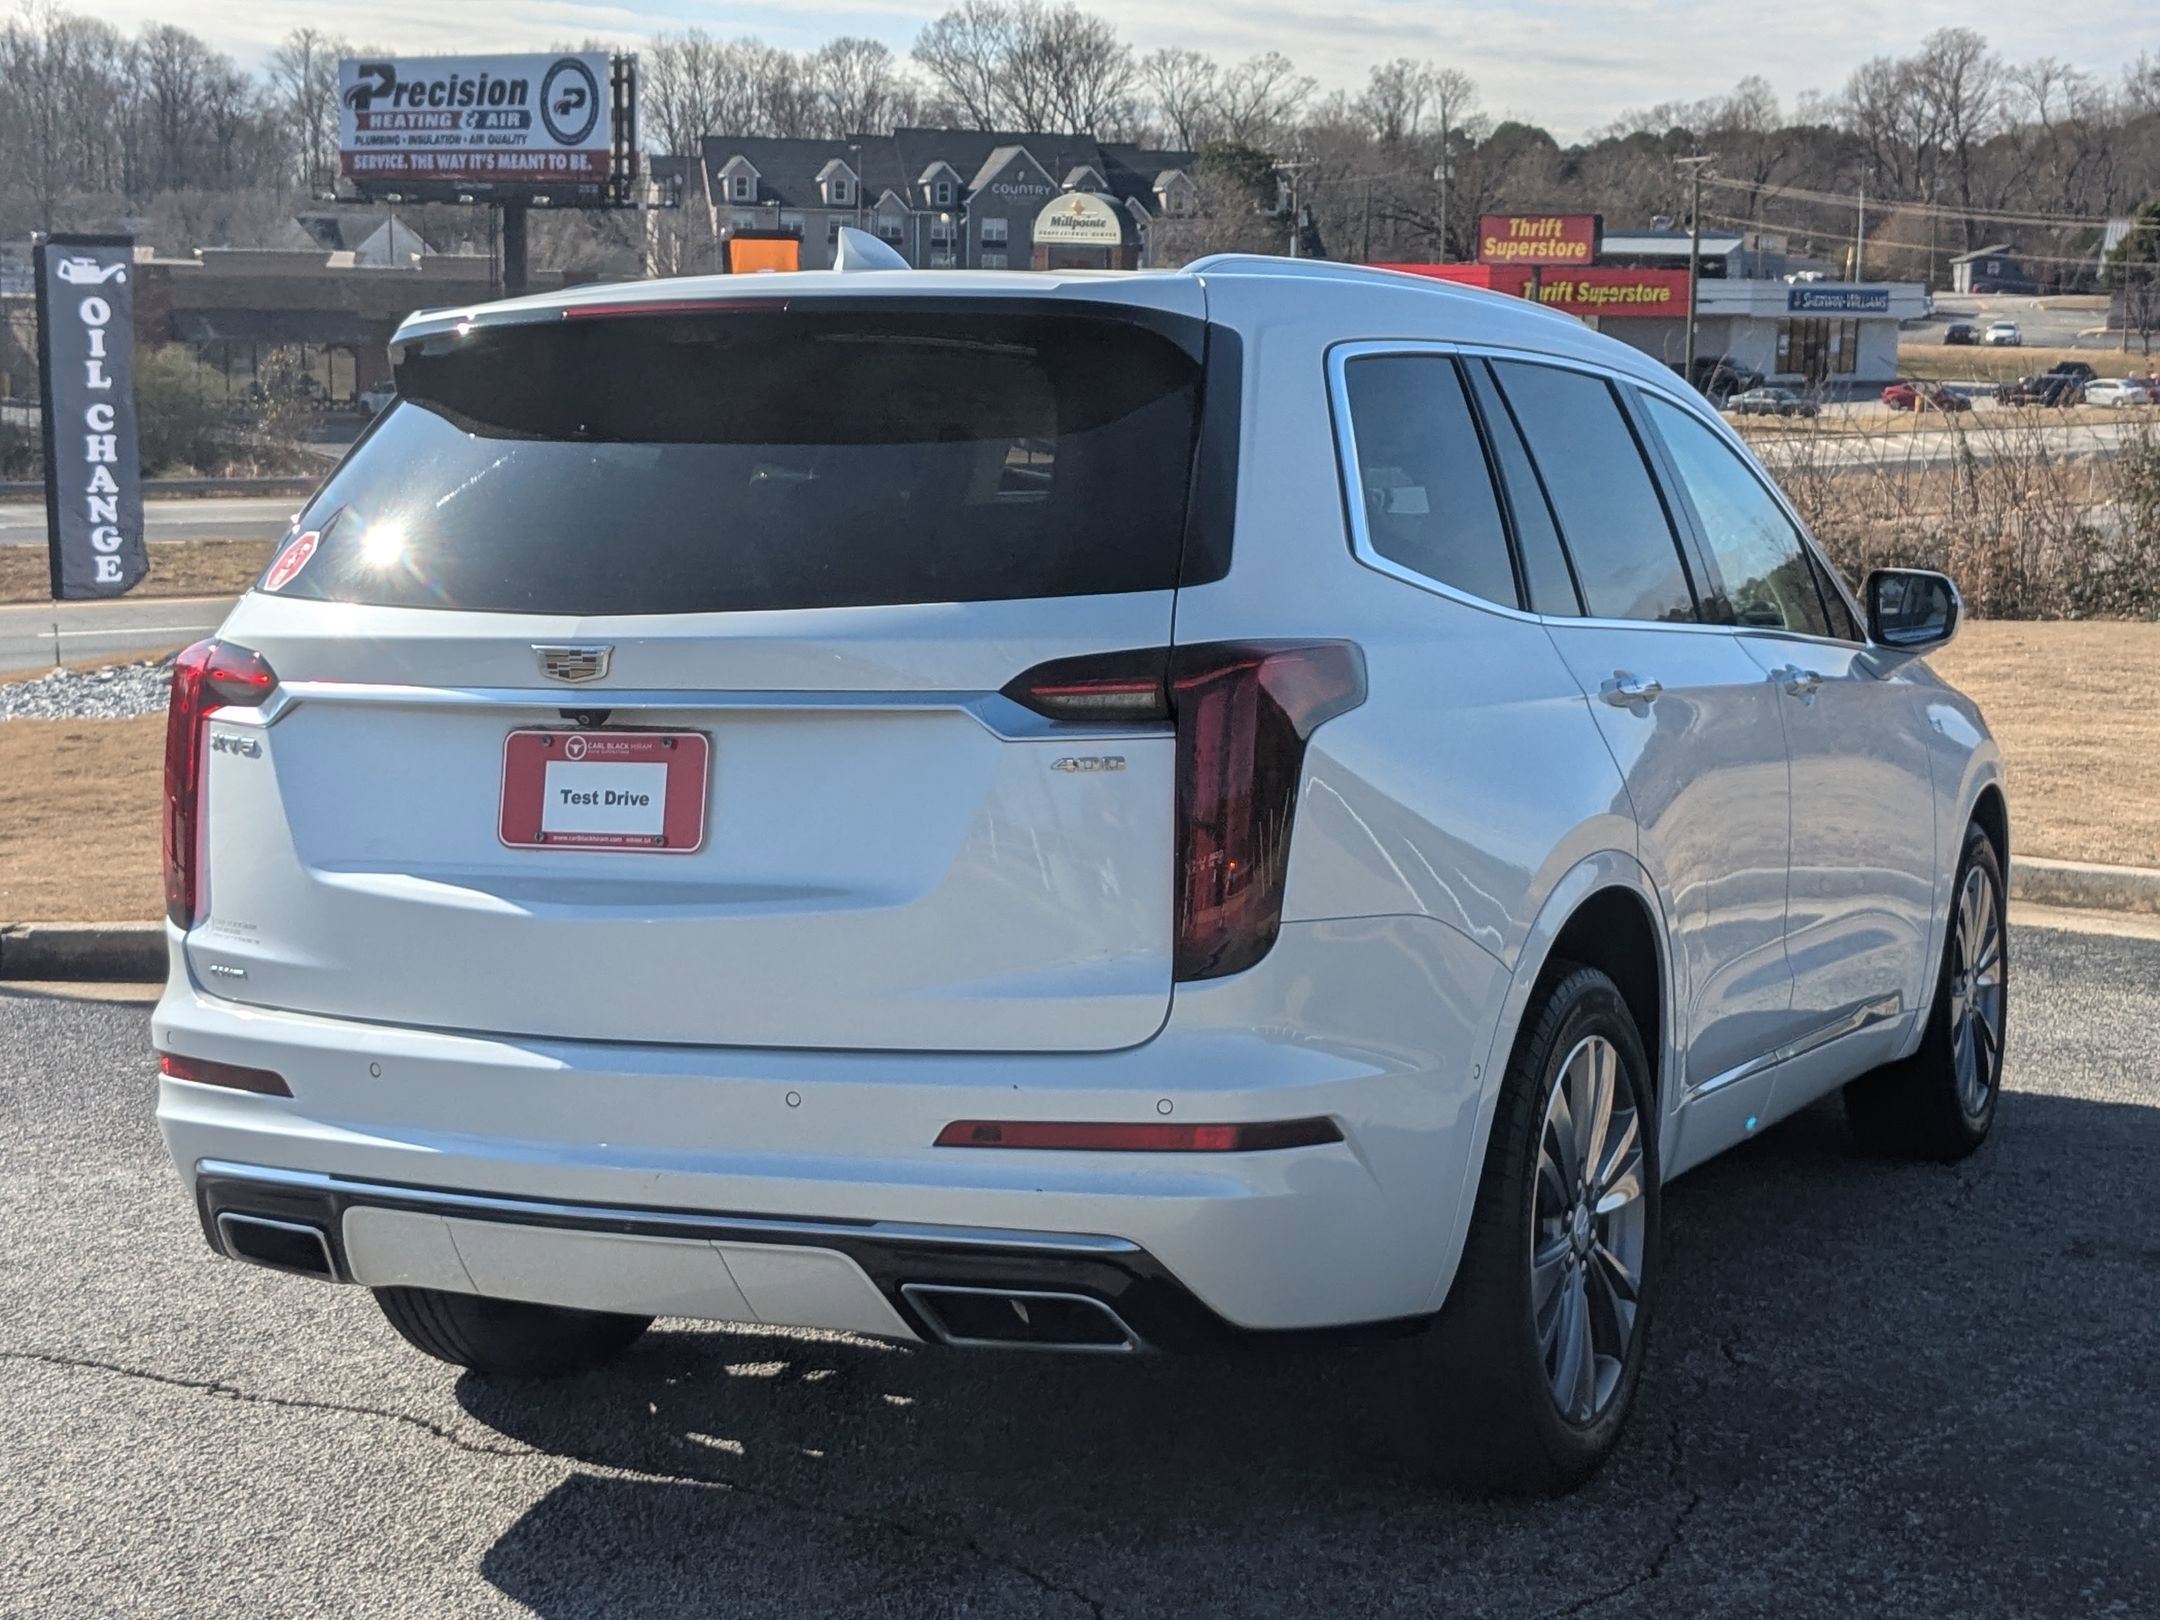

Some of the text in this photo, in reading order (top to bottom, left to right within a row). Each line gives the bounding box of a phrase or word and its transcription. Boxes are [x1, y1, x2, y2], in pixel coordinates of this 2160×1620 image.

[343, 63, 529, 111] Precision
[369, 110, 521, 130] HEATING & AIR
[354, 133, 528, 146] PLUMBING INSULATION AIR QUALITY
[410, 153, 435, 170] THE
[436, 153, 468, 170] WAY
[469, 153, 496, 170] IT'S
[497, 153, 547, 171] MEANT
[548, 153, 568, 170] TO
[569, 153, 593, 171] BE.
[991, 183, 1052, 196] COUNTRY
[1050, 214, 1107, 230] Millpointe
[1509, 218, 1562, 238] Thrift
[1485, 238, 1586, 260] Superstore
[1577, 282, 1670, 304] Superstore
[79, 296, 124, 583] OIL CHANGE
[1050, 756, 1126, 772] 400
[560, 789, 650, 807] Test Drive
